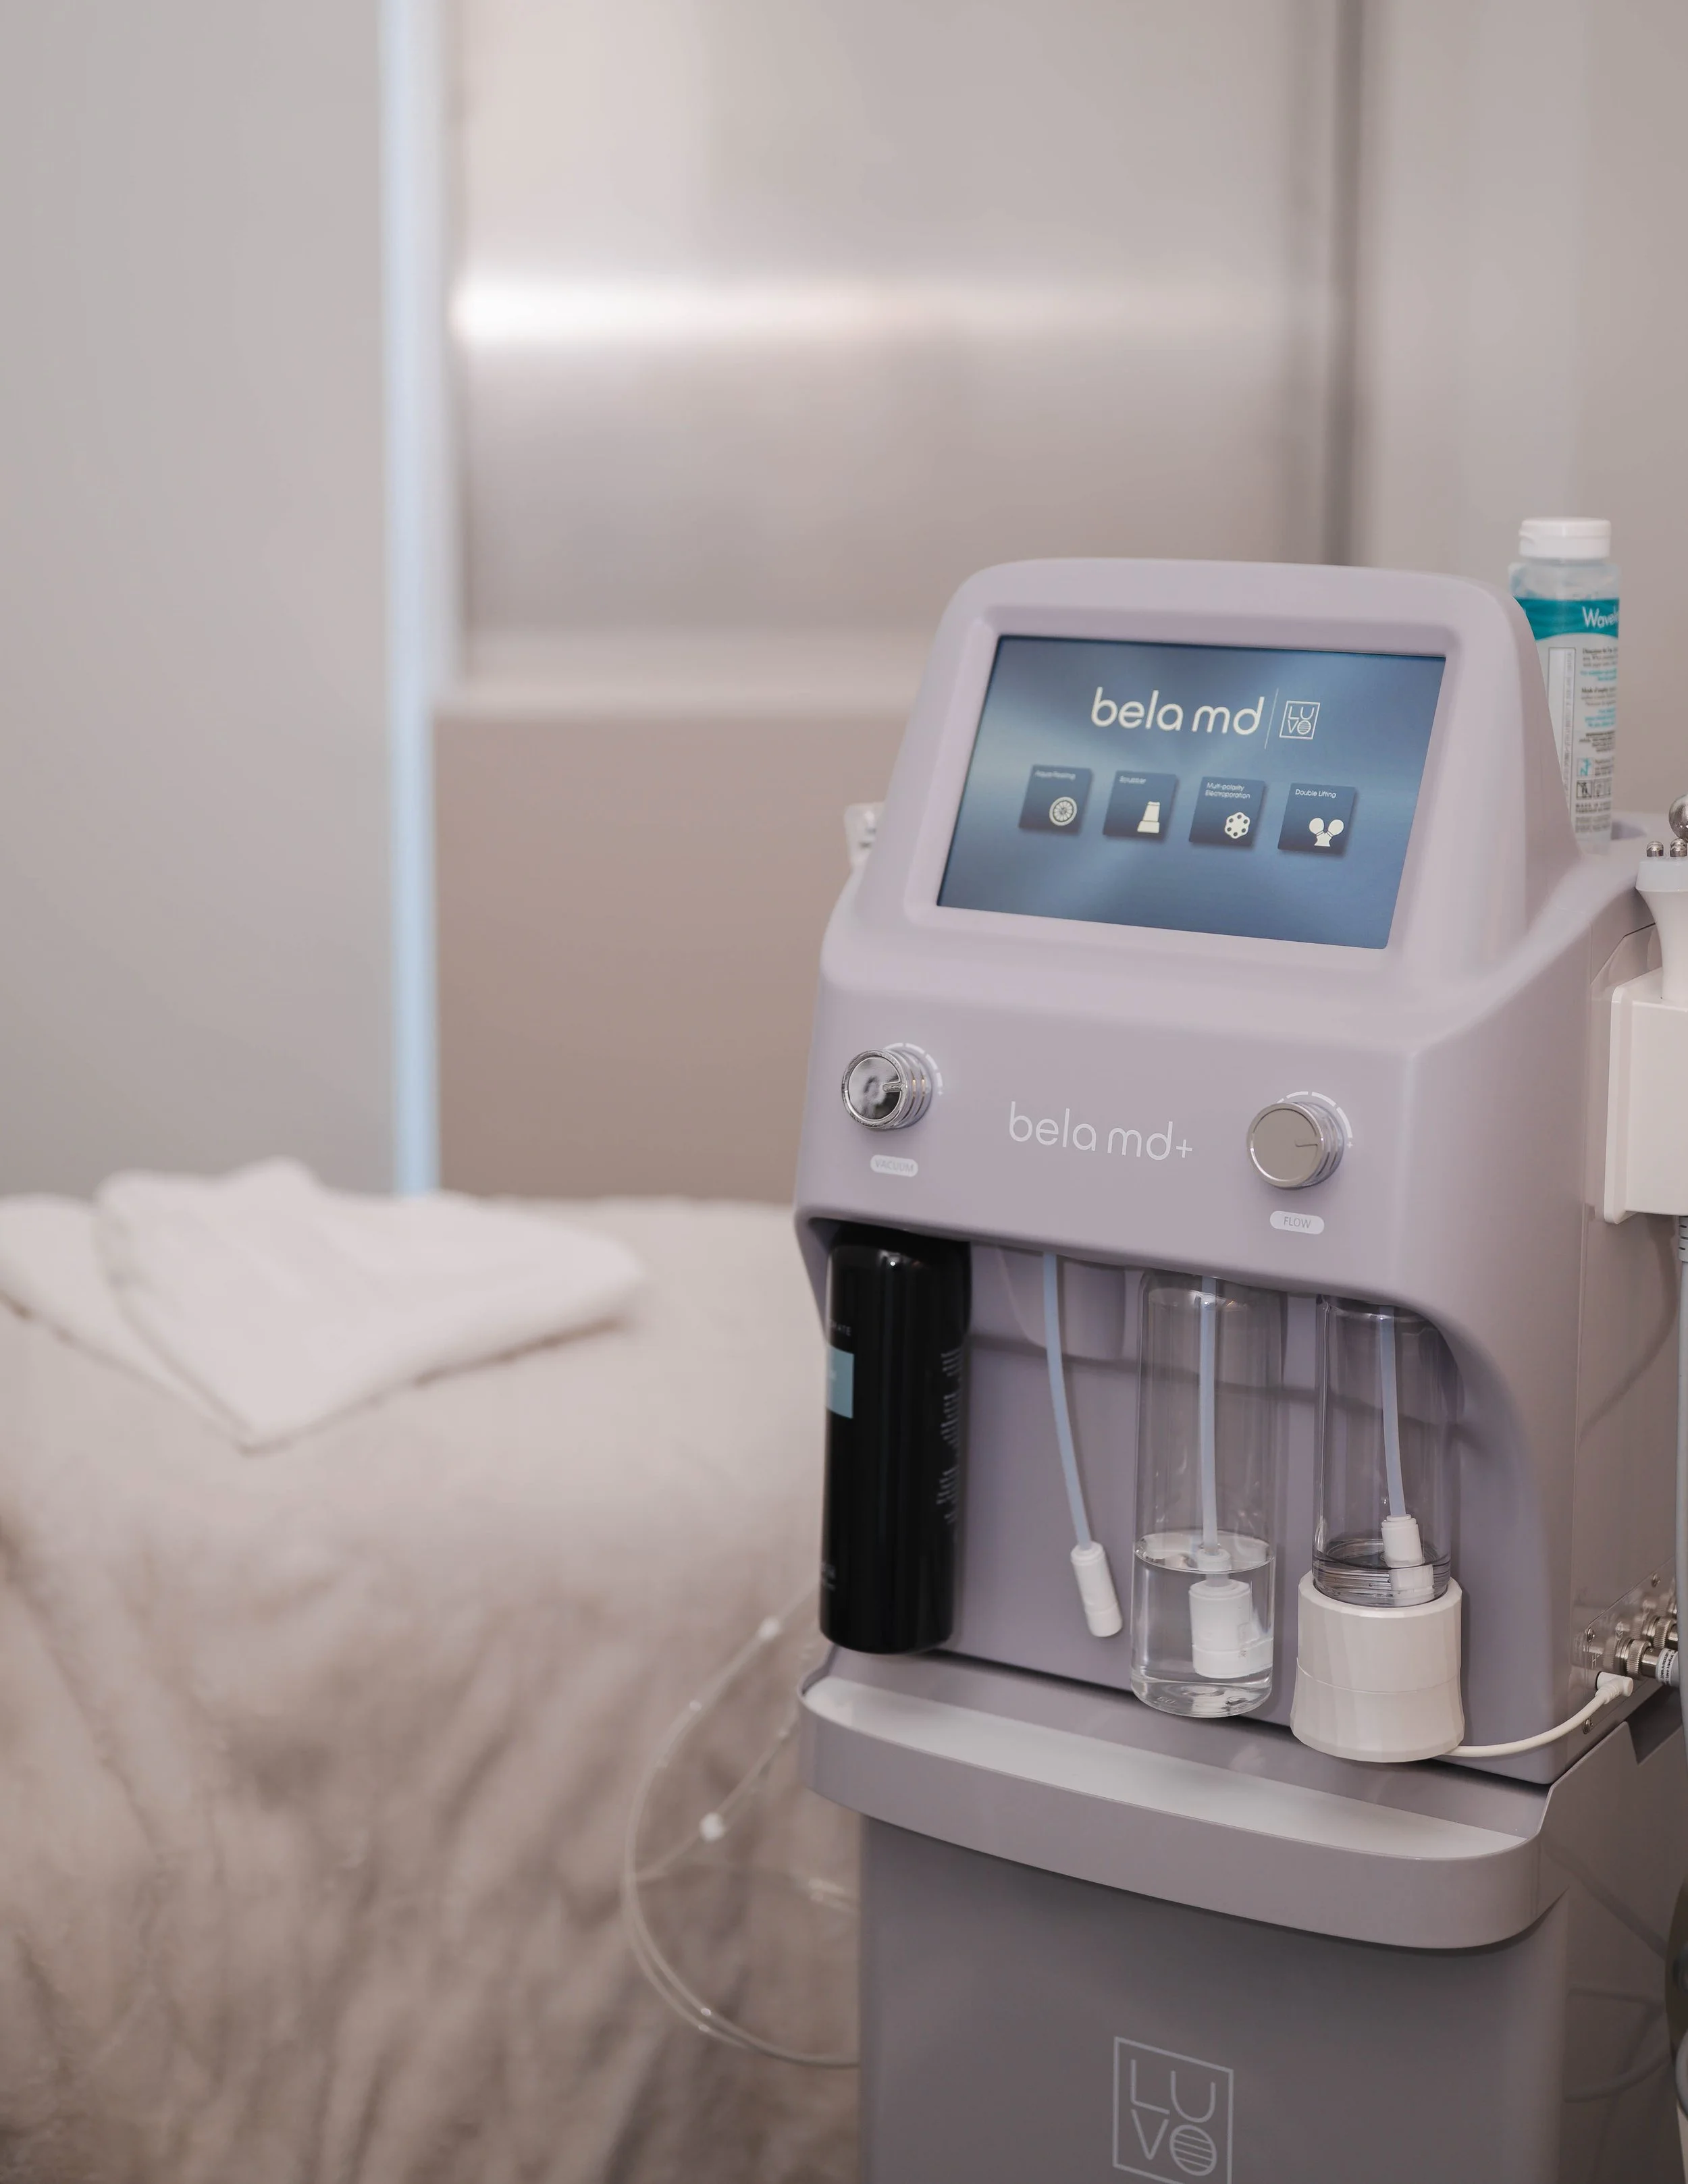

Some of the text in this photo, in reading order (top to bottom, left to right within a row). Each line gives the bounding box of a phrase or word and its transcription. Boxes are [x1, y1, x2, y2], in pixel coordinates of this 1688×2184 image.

[1090, 686, 1265, 736] bela md
[1295, 789, 1337, 799] Double Lifting
[1009, 1100, 1097, 1152] bela
[874, 1158, 914, 1173] VACUUM
[1284, 1216, 1312, 1229] FLOW
